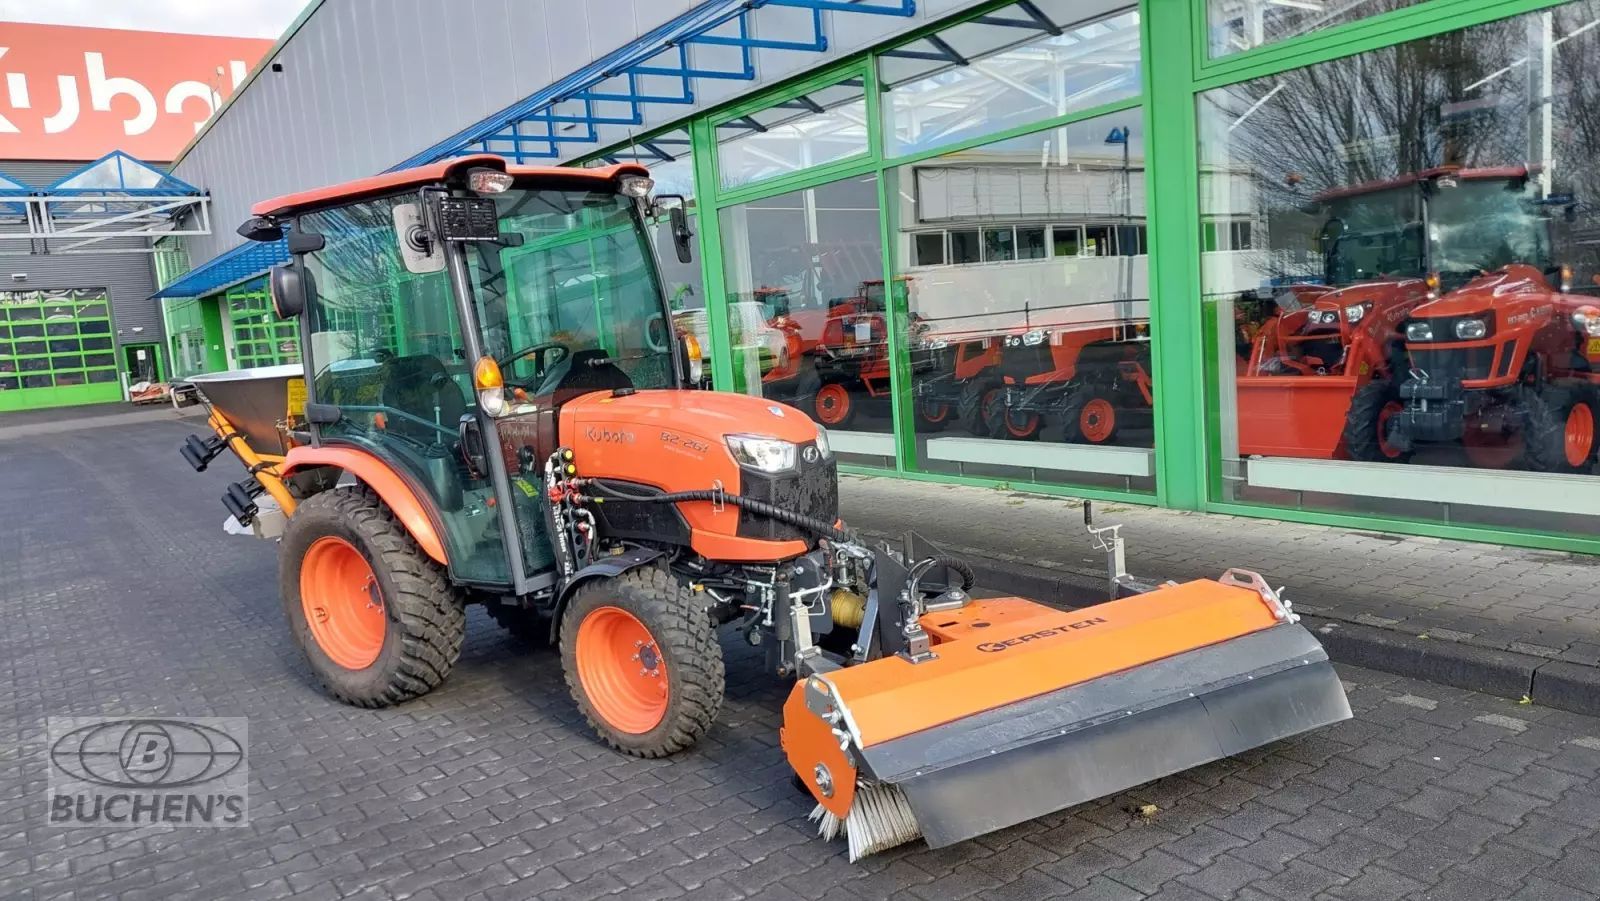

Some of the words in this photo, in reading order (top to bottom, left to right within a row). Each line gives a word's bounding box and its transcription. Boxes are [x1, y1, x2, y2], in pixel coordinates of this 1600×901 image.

[584, 426, 635, 444] Kubota
[660, 431, 709, 453] B2-261
[976, 616, 1107, 653] KERSTEN
